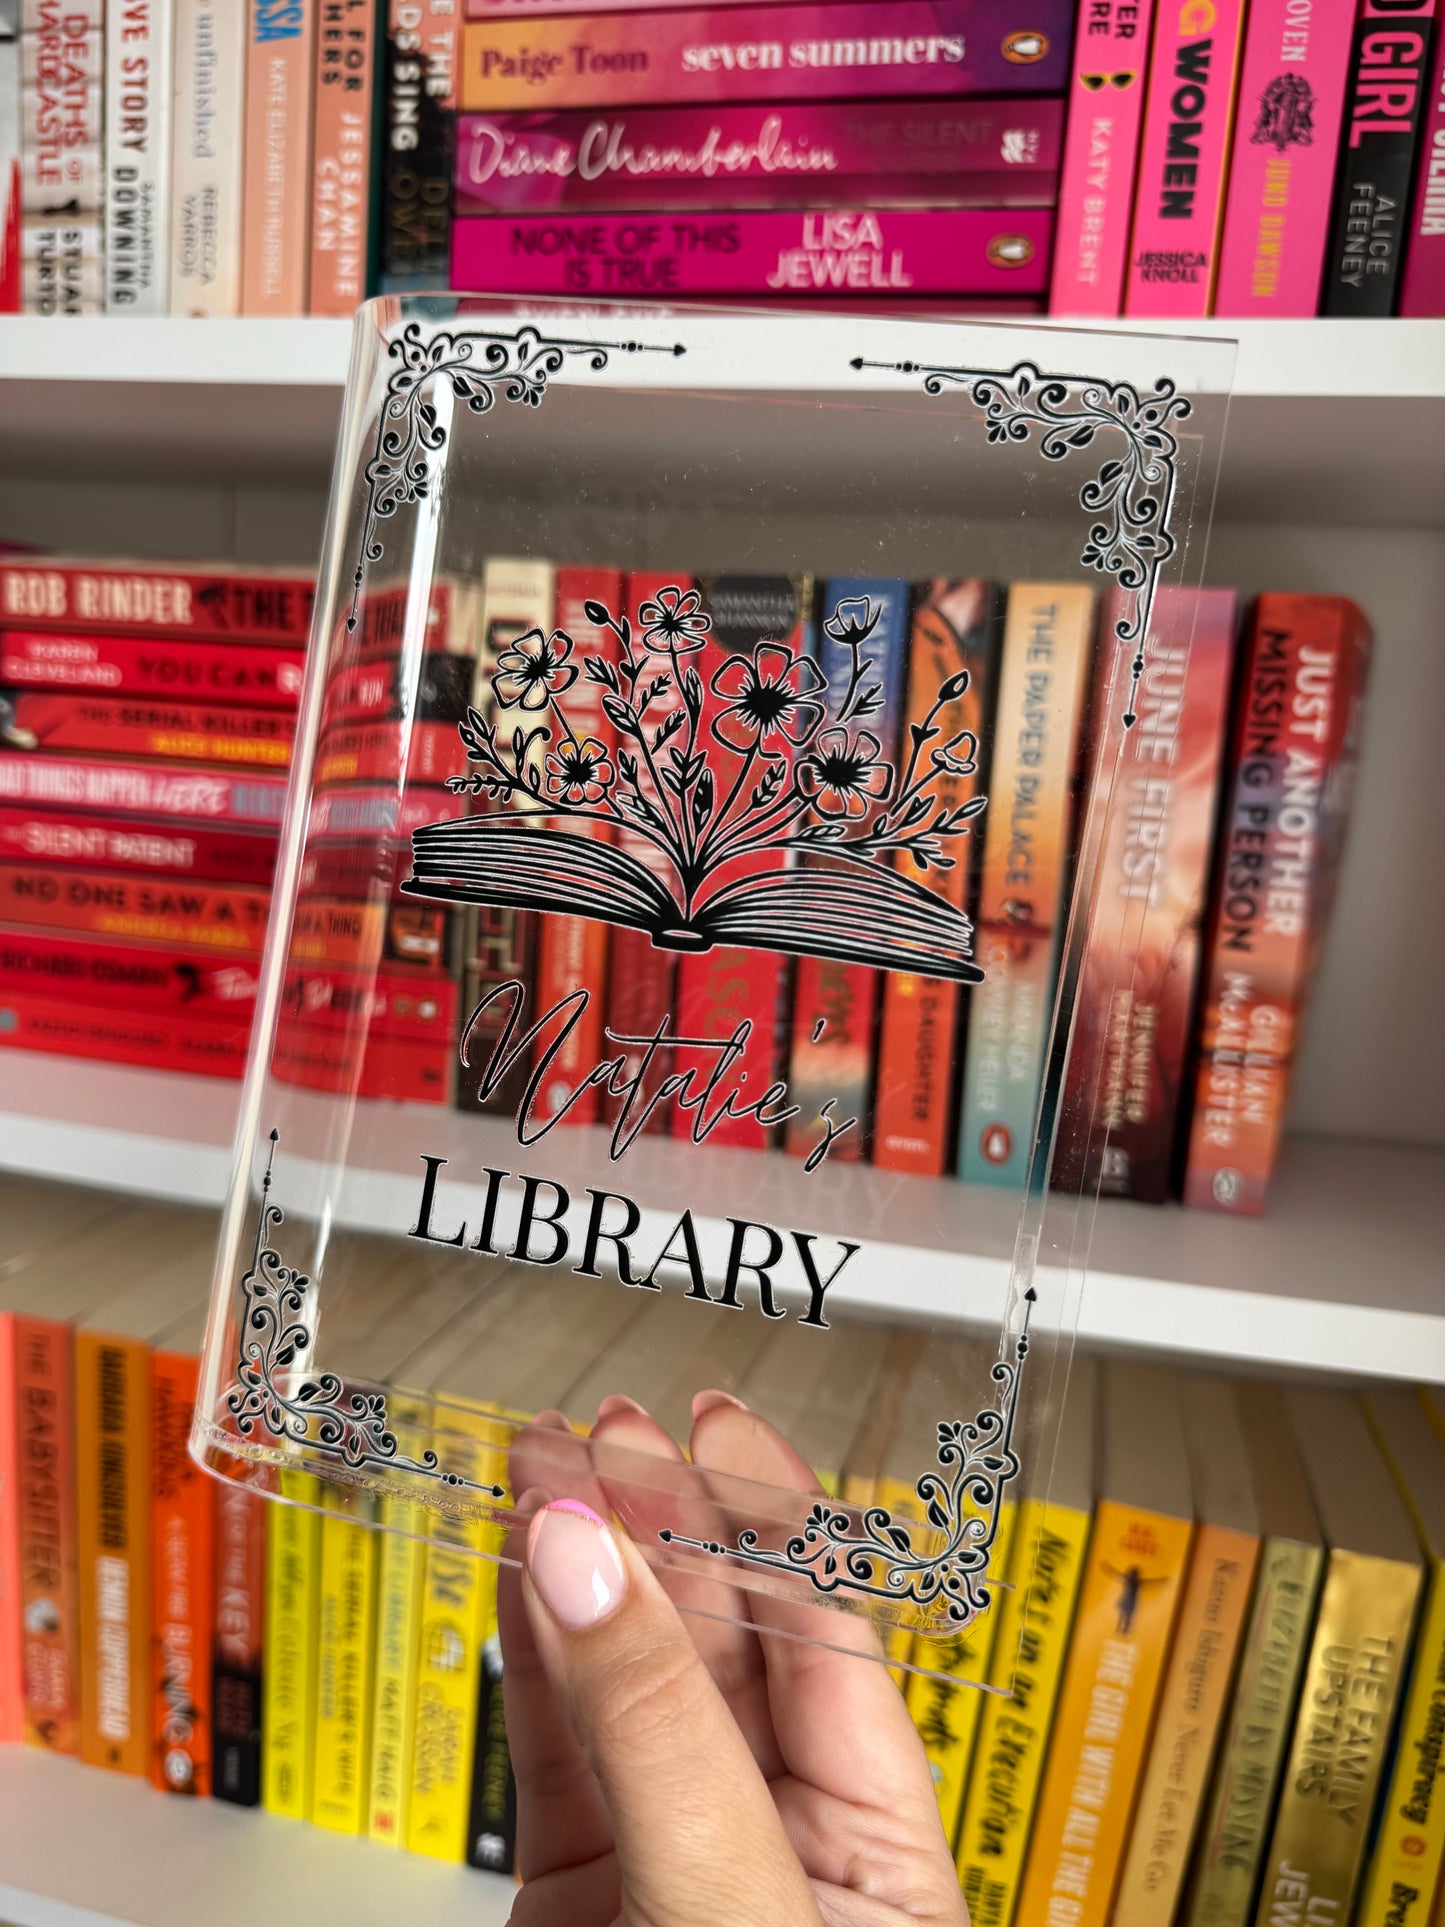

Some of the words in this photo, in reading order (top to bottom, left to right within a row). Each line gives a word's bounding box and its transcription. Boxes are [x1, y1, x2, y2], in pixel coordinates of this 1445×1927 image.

[61, 13, 89, 147] DEATHS
[192, 14, 217, 158] unfinished
[268, 58, 288, 103] KATE
[345, 29, 366, 92] FOR
[426, 31, 455, 96] THE
[481, 49, 564, 84] Paige
[572, 44, 648, 73] Toon
[682, 44, 780, 71] seven
[789, 35, 965, 69] summers
[1350, 31, 1424, 148] GIRL
[120, 57, 148, 153] STORY
[391, 61, 420, 151] SING
[1158, 38, 1213, 219] WOMEN
[264, 110, 286, 209] ELIZABETH
[468, 122, 578, 184] Diane
[577, 115, 839, 180] Chamberlain
[1086, 117, 1113, 189] KATY
[1262, 158, 1291, 207] JUNO
[112, 165, 138, 305] DOWNING
[199, 185, 219, 286] REBECCA
[318, 157, 340, 250] CHAN
[334, 112, 363, 297] JESSAMINE
[510, 227, 604, 255] NONE
[614, 224, 661, 252] OF
[668, 223, 741, 253] THIS
[802, 212, 883, 250] LISA
[1076, 195, 1106, 287] BRENT
[1340, 182, 1376, 288] FEENEY
[1365, 194, 1397, 275] ALICE
[259, 215, 284, 297] RUSSELL
[564, 260, 590, 288] IS
[601, 257, 679, 288] TRUE
[766, 248, 912, 288] JEWELL
[1133, 250, 1209, 268] JESSICA
[1140, 268, 1200, 284] KNOLL
[1252, 214, 1286, 297] DAWSON
[3, 571, 67, 617] ROB
[76, 575, 194, 625] RINDER
[234, 585, 293, 630] THE
[1026, 602, 1056, 664] THE
[137, 656, 203, 684] YOU
[1136, 634, 1188, 765] JUNE
[1289, 643, 1335, 742] JUST
[120, 708, 193, 730] SERIAL
[1018, 670, 1049, 768] PAPER
[1241, 627, 1291, 789] MISSING
[24, 822, 106, 858] SILENT
[1005, 774, 1040, 886] PALACE
[1119, 777, 1173, 907] FIRST
[1263, 748, 1321, 938] ANOTHER
[13, 875, 58, 903] NO
[69, 880, 125, 907] ONE
[139, 890, 205, 916] SAW
[1222, 801, 1271, 953] PERSON
[460, 979, 857, 1174] Natalie's
[912, 997, 941, 1121] DAUGHTER
[1124, 1001, 1158, 1124] JENNIFER
[406, 1154, 862, 1331] LIBRARY
[27, 1333, 48, 1375] THE
[24, 1385, 62, 1588] BABYSITTER
[96, 1555, 129, 1621] DEMON
[346, 1571, 363, 1641] SERIAL
[1016, 1525, 1071, 1627] Notes
[1203, 1557, 1240, 1624] Kazuo
[218, 1587, 250, 1654] KEY
[386, 1571, 407, 1674] LIBRARY
[1016, 1628, 1042, 1667] on
[1255, 1579, 1307, 1714] ELIZABETH
[98, 1622, 130, 1741] COPPERHEAD
[163, 1622, 192, 1744] BURNING
[1009, 1670, 1036, 1711] an
[1096, 1638, 1138, 1688] THE
[1184, 1628, 1224, 1714] Ishiguro
[1350, 1633, 1394, 1701] THE
[376, 1676, 400, 1737] MATT
[416, 1682, 446, 1795] CROSSAN
[1084, 1684, 1129, 1745] GIRL
[1244, 1722, 1274, 1751] IS
[1296, 1644, 1354, 1798] UPSTAIRS
[334, 1747, 355, 1797] WIFE
[371, 1743, 398, 1800] HAIG
[439, 1706, 464, 1784] SARAH
[1072, 1744, 1115, 1811] WITH
[1167, 1722, 1200, 1785] Never
[1328, 1706, 1383, 1826] FAMILY
[977, 1713, 1040, 1859] Execution
[1156, 1784, 1188, 1827] Let
[1219, 1761, 1267, 1872] MISSING
[1061, 1805, 1101, 1850] ALL
[1149, 1824, 1178, 1859] Me
[1052, 1849, 1094, 1899] THE
[1303, 1894, 1340, 1927] LI
